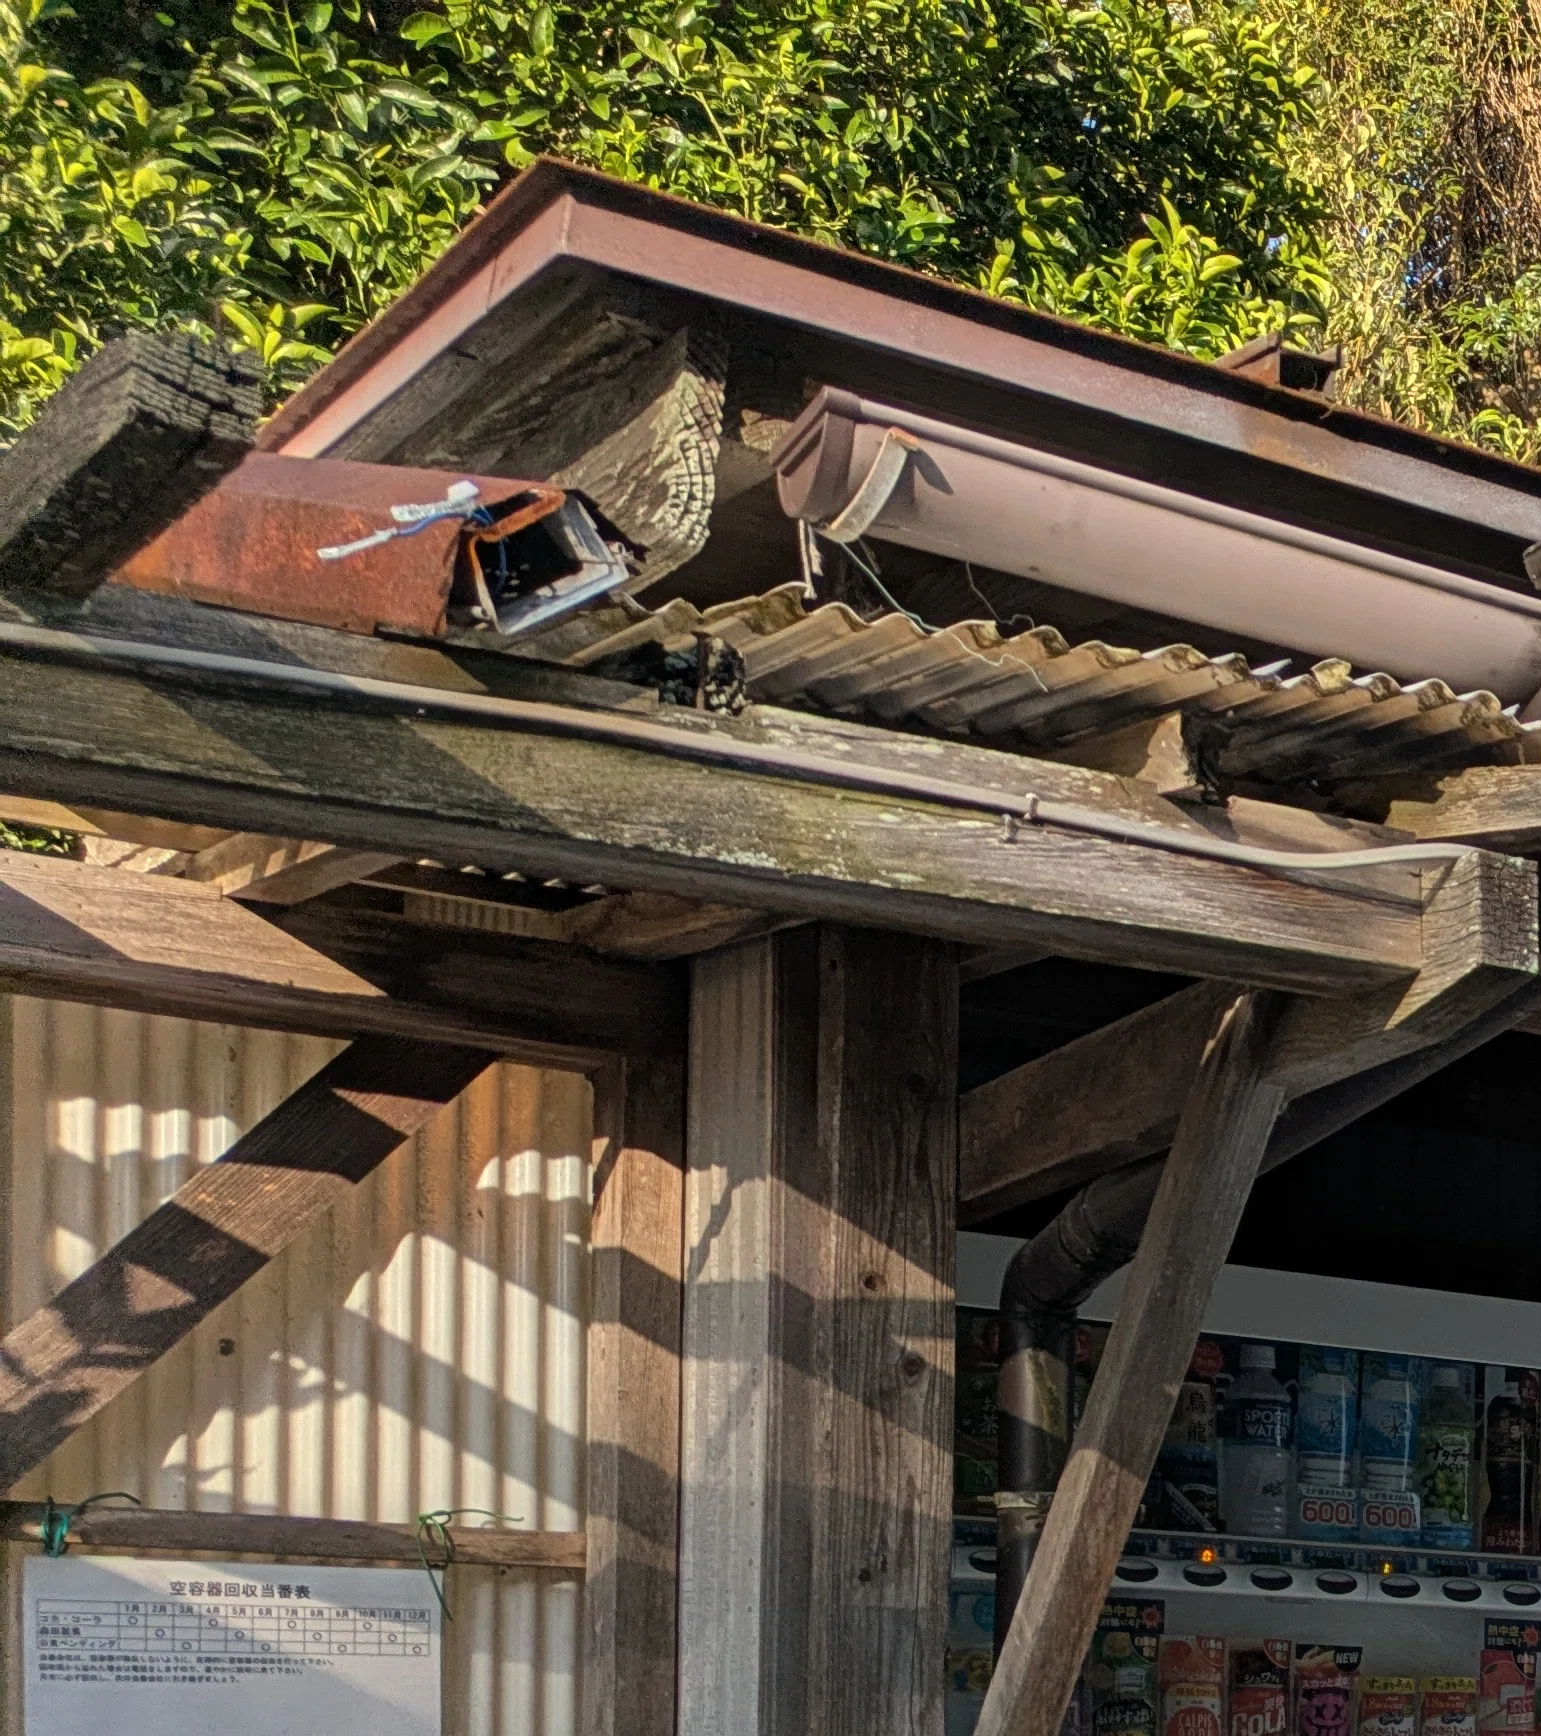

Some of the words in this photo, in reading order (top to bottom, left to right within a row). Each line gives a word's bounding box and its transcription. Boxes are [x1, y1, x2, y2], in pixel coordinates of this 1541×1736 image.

[1302, 1500, 1351, 1522] 600
[1365, 1504, 1413, 1528] 600
[169, 1580, 311, 1600] 空容器回収当番表
[126, 1604, 140, 1613] 1月
[152, 1605, 167, 1614] 2月
[179, 1605, 194, 1615] 3月
[206, 1606, 220, 1615] 4月
[232, 1607, 246, 1616] 5月
[258, 1608, 273, 1617] 6月
[285, 1608, 299, 1617] 7月
[310, 1608, 324, 1618] 8月
[335, 1609, 349, 1618] 9月
[358, 1609, 376, 1619] 10月
[383, 1610, 401, 1619] 11月
[408, 1610, 426, 1620] 12月
[1335, 1651, 1359, 1665] NEW
